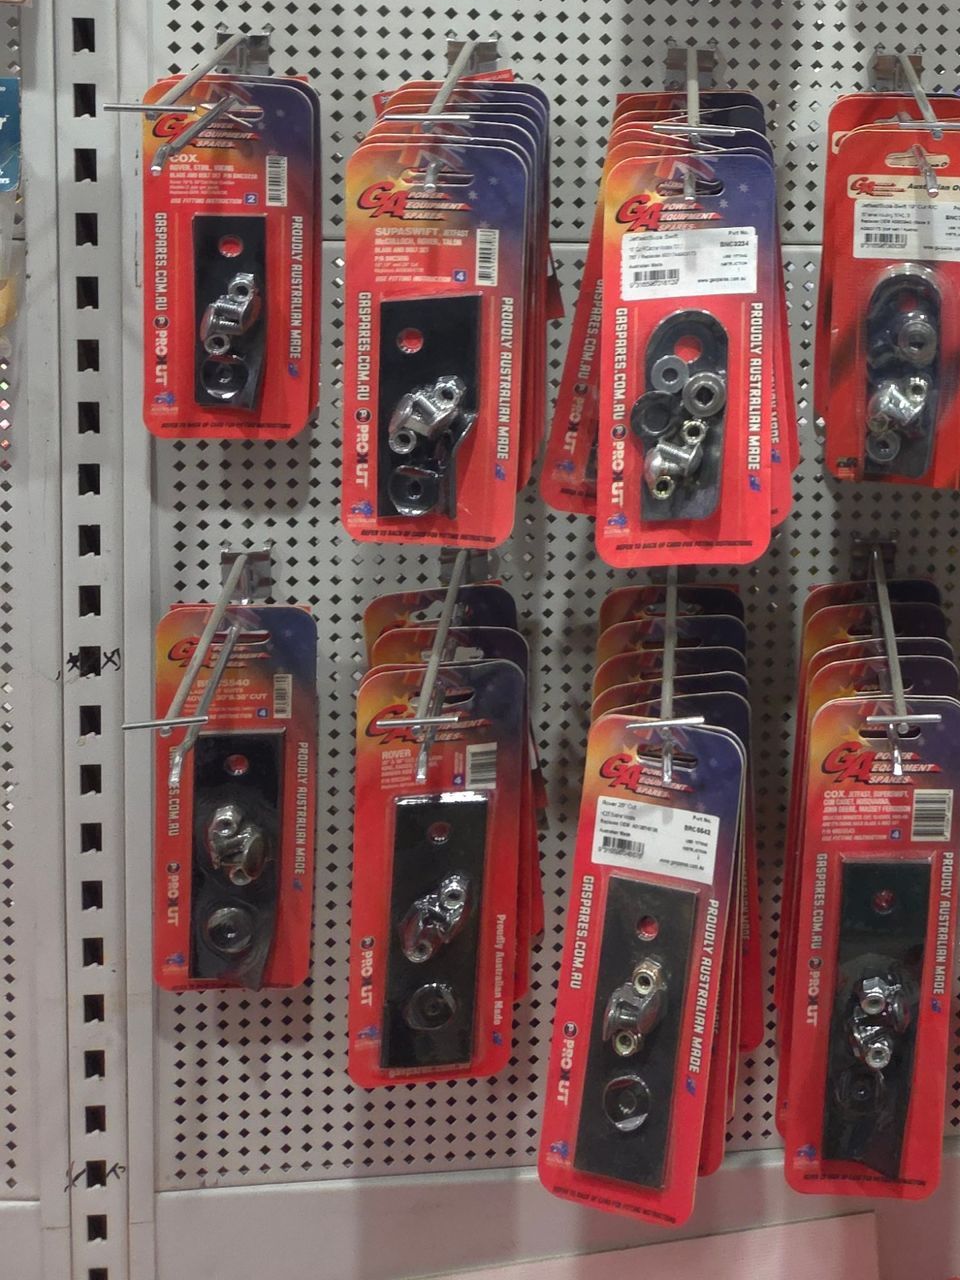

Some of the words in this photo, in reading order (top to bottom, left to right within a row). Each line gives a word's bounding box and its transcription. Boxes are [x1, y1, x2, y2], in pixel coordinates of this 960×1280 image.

[247, 194, 255, 204] 2
[357, 181, 408, 220] GA
[615, 194, 664, 233] GA
[154, 212, 168, 311] GASPARES.COM.AU
[291, 215, 305, 266] PROUDLY
[290, 269, 304, 328] AUSTRALIAN
[456, 271, 465, 281] 4
[288, 329, 303, 359] MADE
[356, 291, 372, 401] GASPARES.COM.AU
[499, 297, 515, 349] PROUDLY
[749, 302, 763, 354] PROUDLY
[499, 351, 513, 423] AUSTRALIAN
[612, 306, 629, 427] GASPARES.COM.AU
[748, 356, 763, 432] AUSTRALIAN
[496, 425, 511, 461] MADE
[747, 433, 761, 470] MADE
[259, 708, 267, 717] 4
[297, 741, 309, 785] PROUDLY
[822, 741, 877, 783] GA
[295, 786, 309, 853] AUSTRALIAN
[892, 830, 900, 839] 4
[294, 853, 307, 875] MADE
[940, 852, 955, 899] PROUDLY
[706, 899, 720, 953] PROUDLY
[811, 853, 828, 950] GASPARES.COM.AU
[570, 875, 594, 990] GASPARES.COM.AU
[935, 900, 951, 963] AUSTRALIAN
[694, 954, 714, 1035] AUSTRALIAN
[932, 964, 945, 995] MADE
[688, 1036, 704, 1074] MADE
